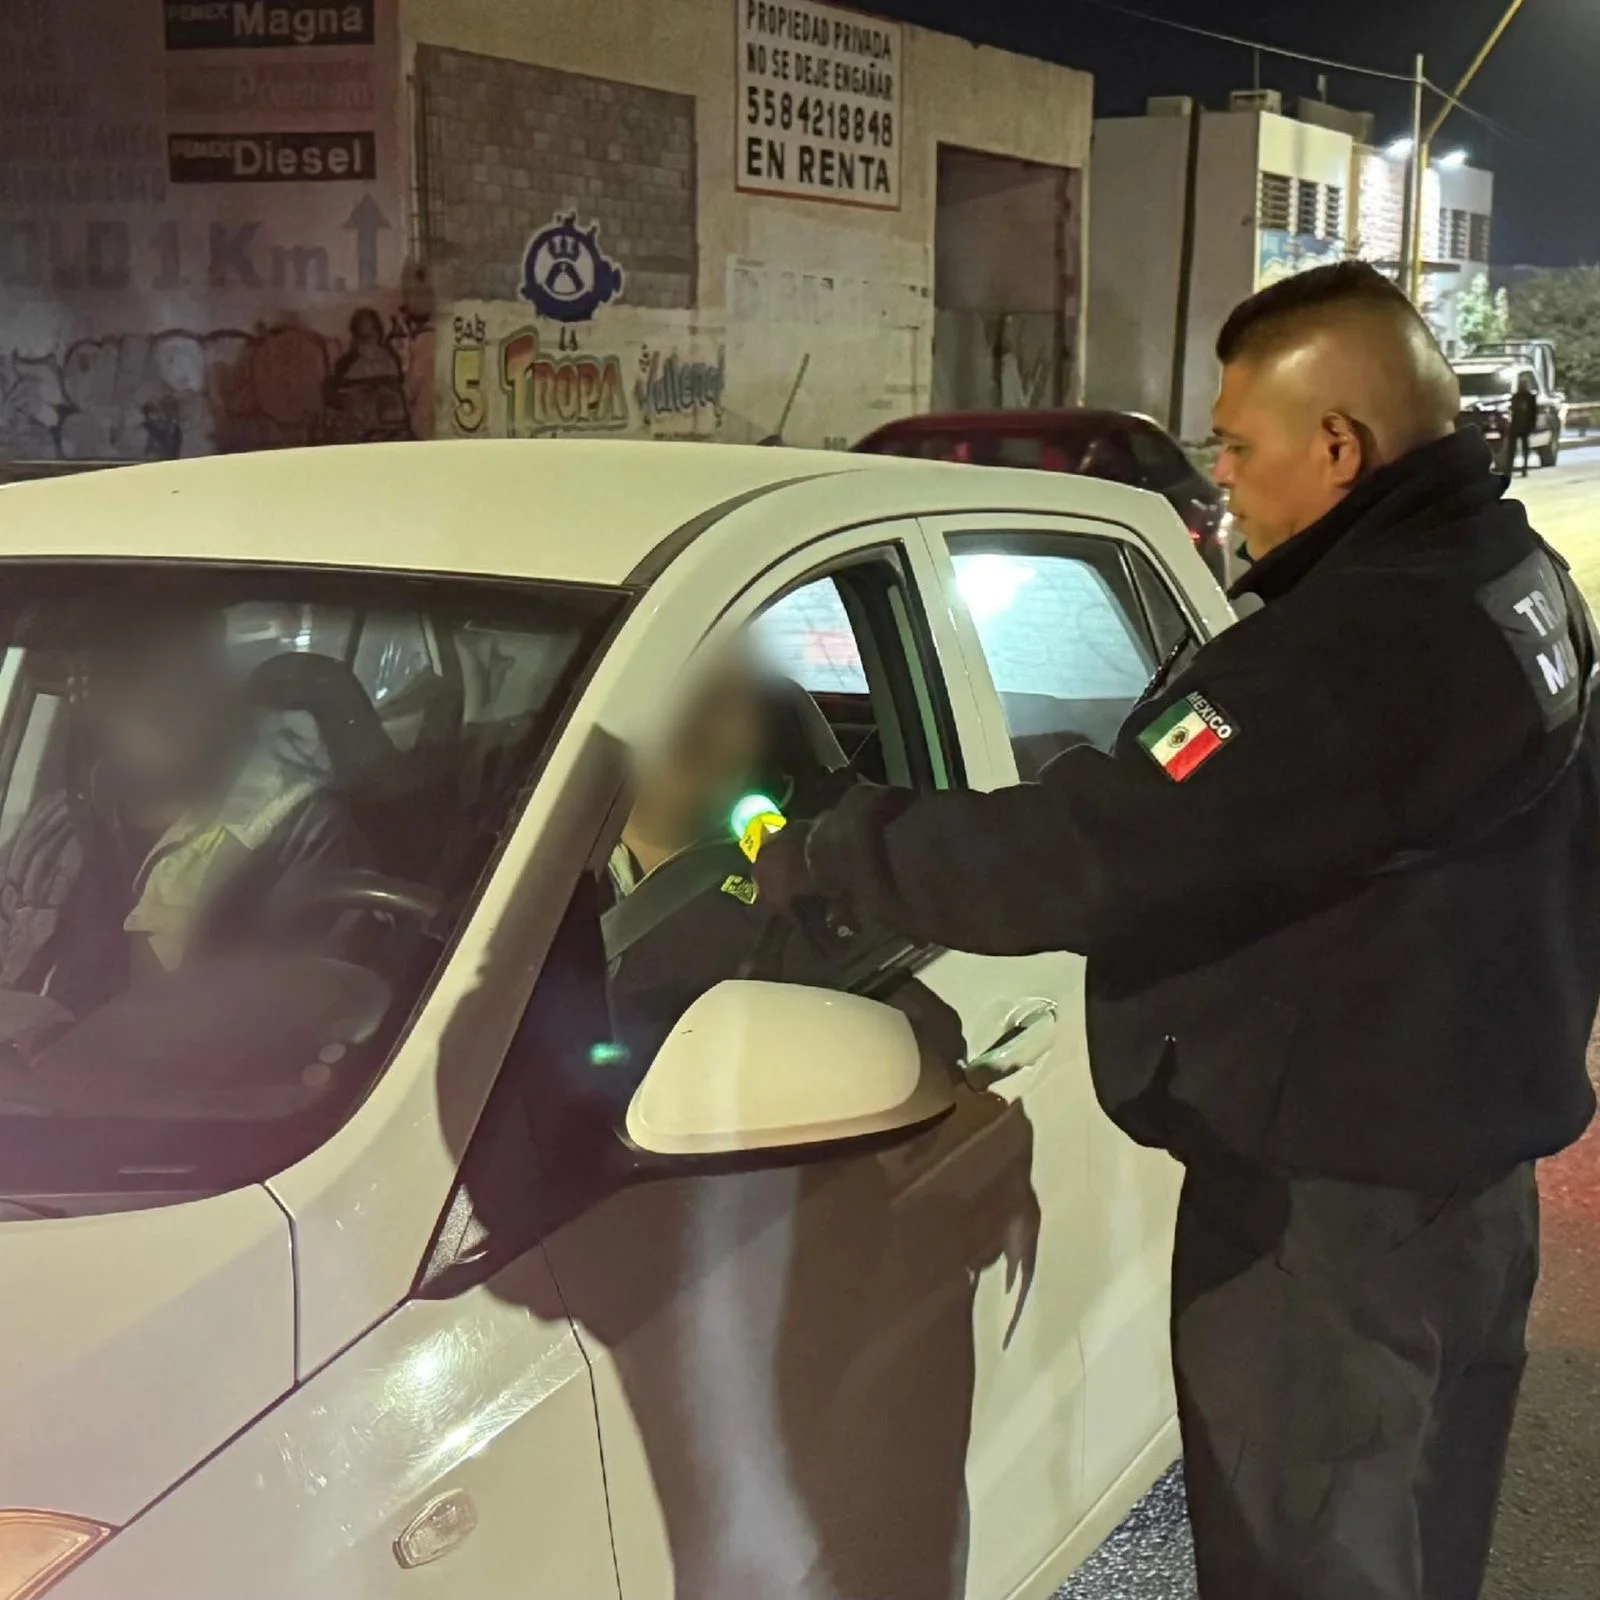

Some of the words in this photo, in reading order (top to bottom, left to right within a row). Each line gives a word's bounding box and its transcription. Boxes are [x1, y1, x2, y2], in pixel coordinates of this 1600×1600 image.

[232, 1, 364, 43] Magna
[746, 0, 830, 48] PROPIEDAD
[833, 20, 892, 61] PRIVADA
[747, 42, 767, 75] NO
[771, 49, 790, 80] SE
[794, 53, 830, 88] DEJE
[834, 62, 893, 101] ENGAÑAR
[233, 138, 363, 176] Diesel
[747, 136, 785, 180] EN
[798, 145, 890, 193] RENTA
[1186, 691, 1232, 739] MEXICO
